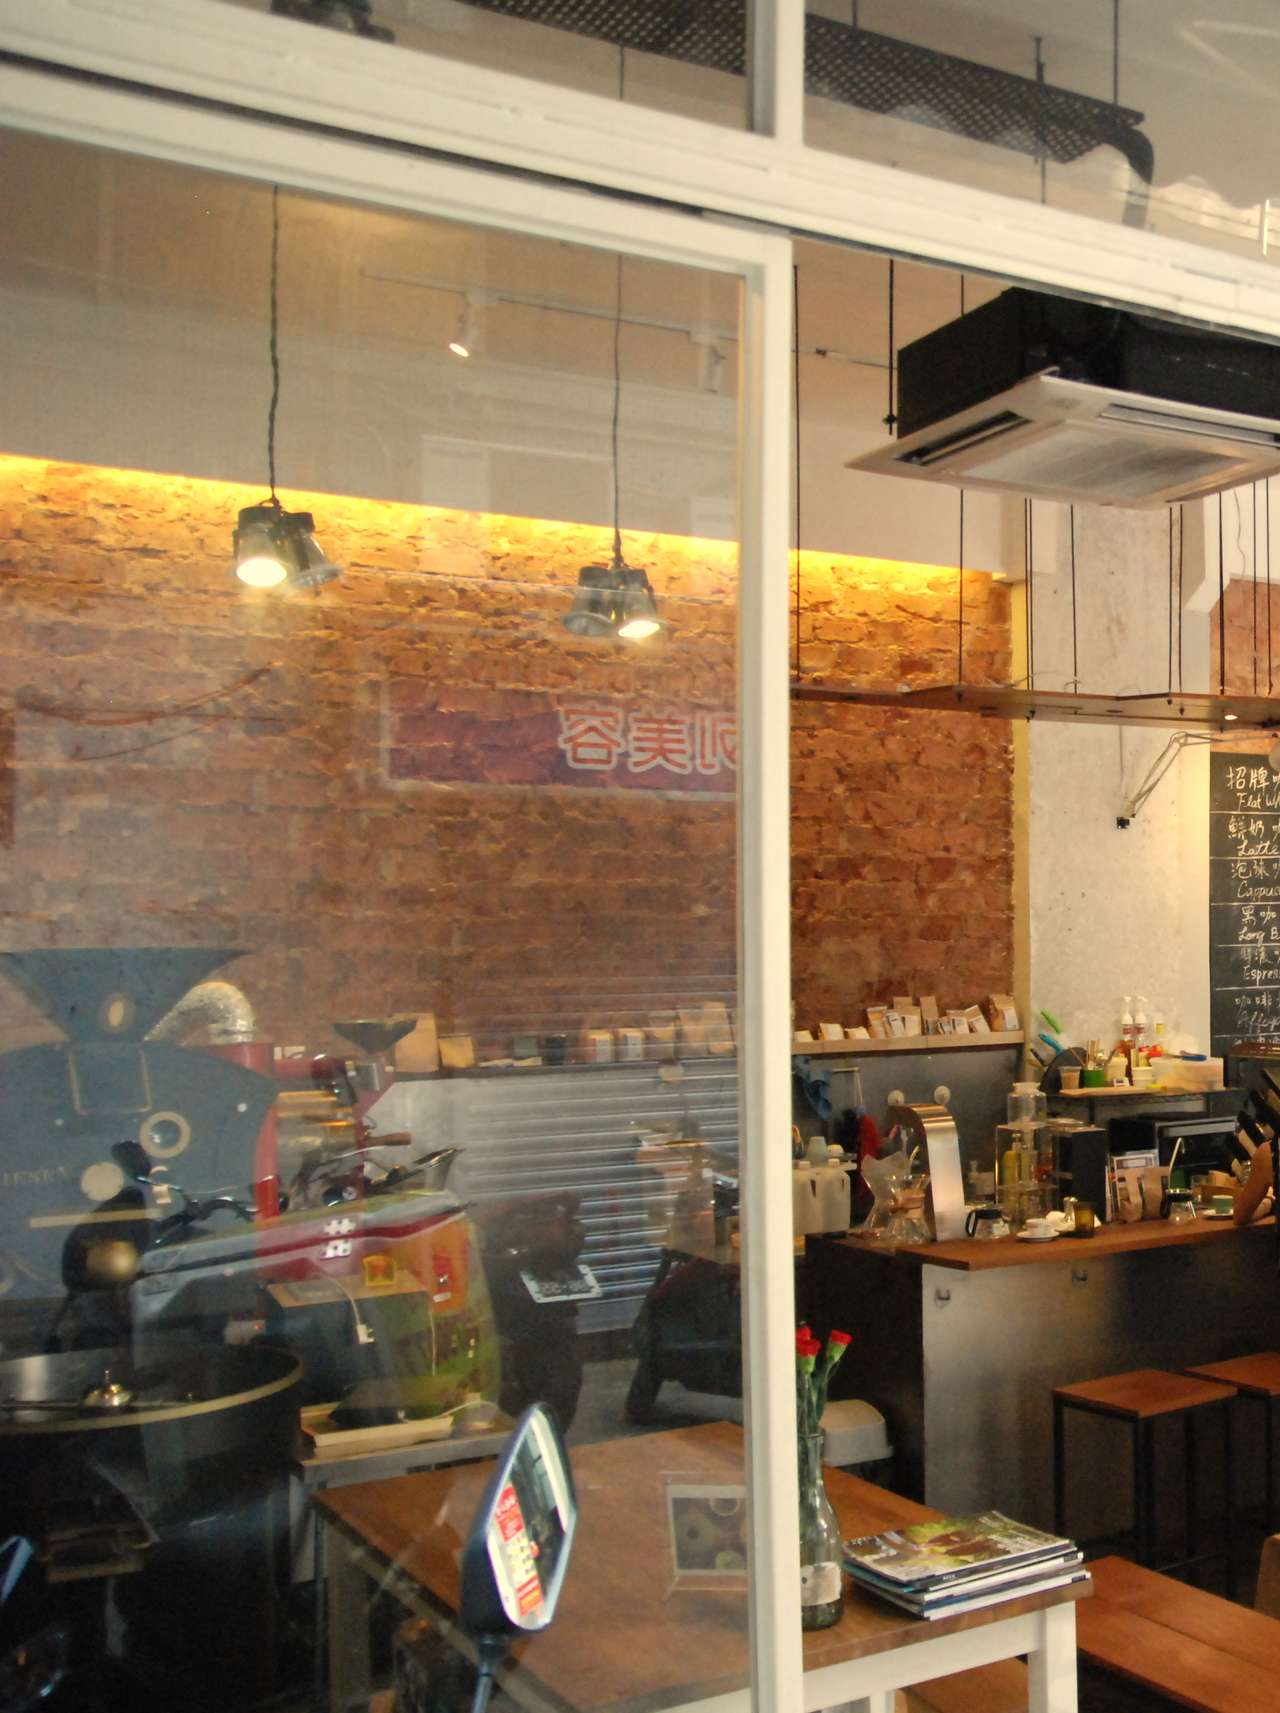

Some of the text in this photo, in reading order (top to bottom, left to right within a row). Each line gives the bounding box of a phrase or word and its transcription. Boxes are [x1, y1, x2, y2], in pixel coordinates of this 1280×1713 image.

[1237, 792, 1262, 811] Flat
[1237, 839, 1280, 858] Latte
[1237, 926, 1266, 948] Long
